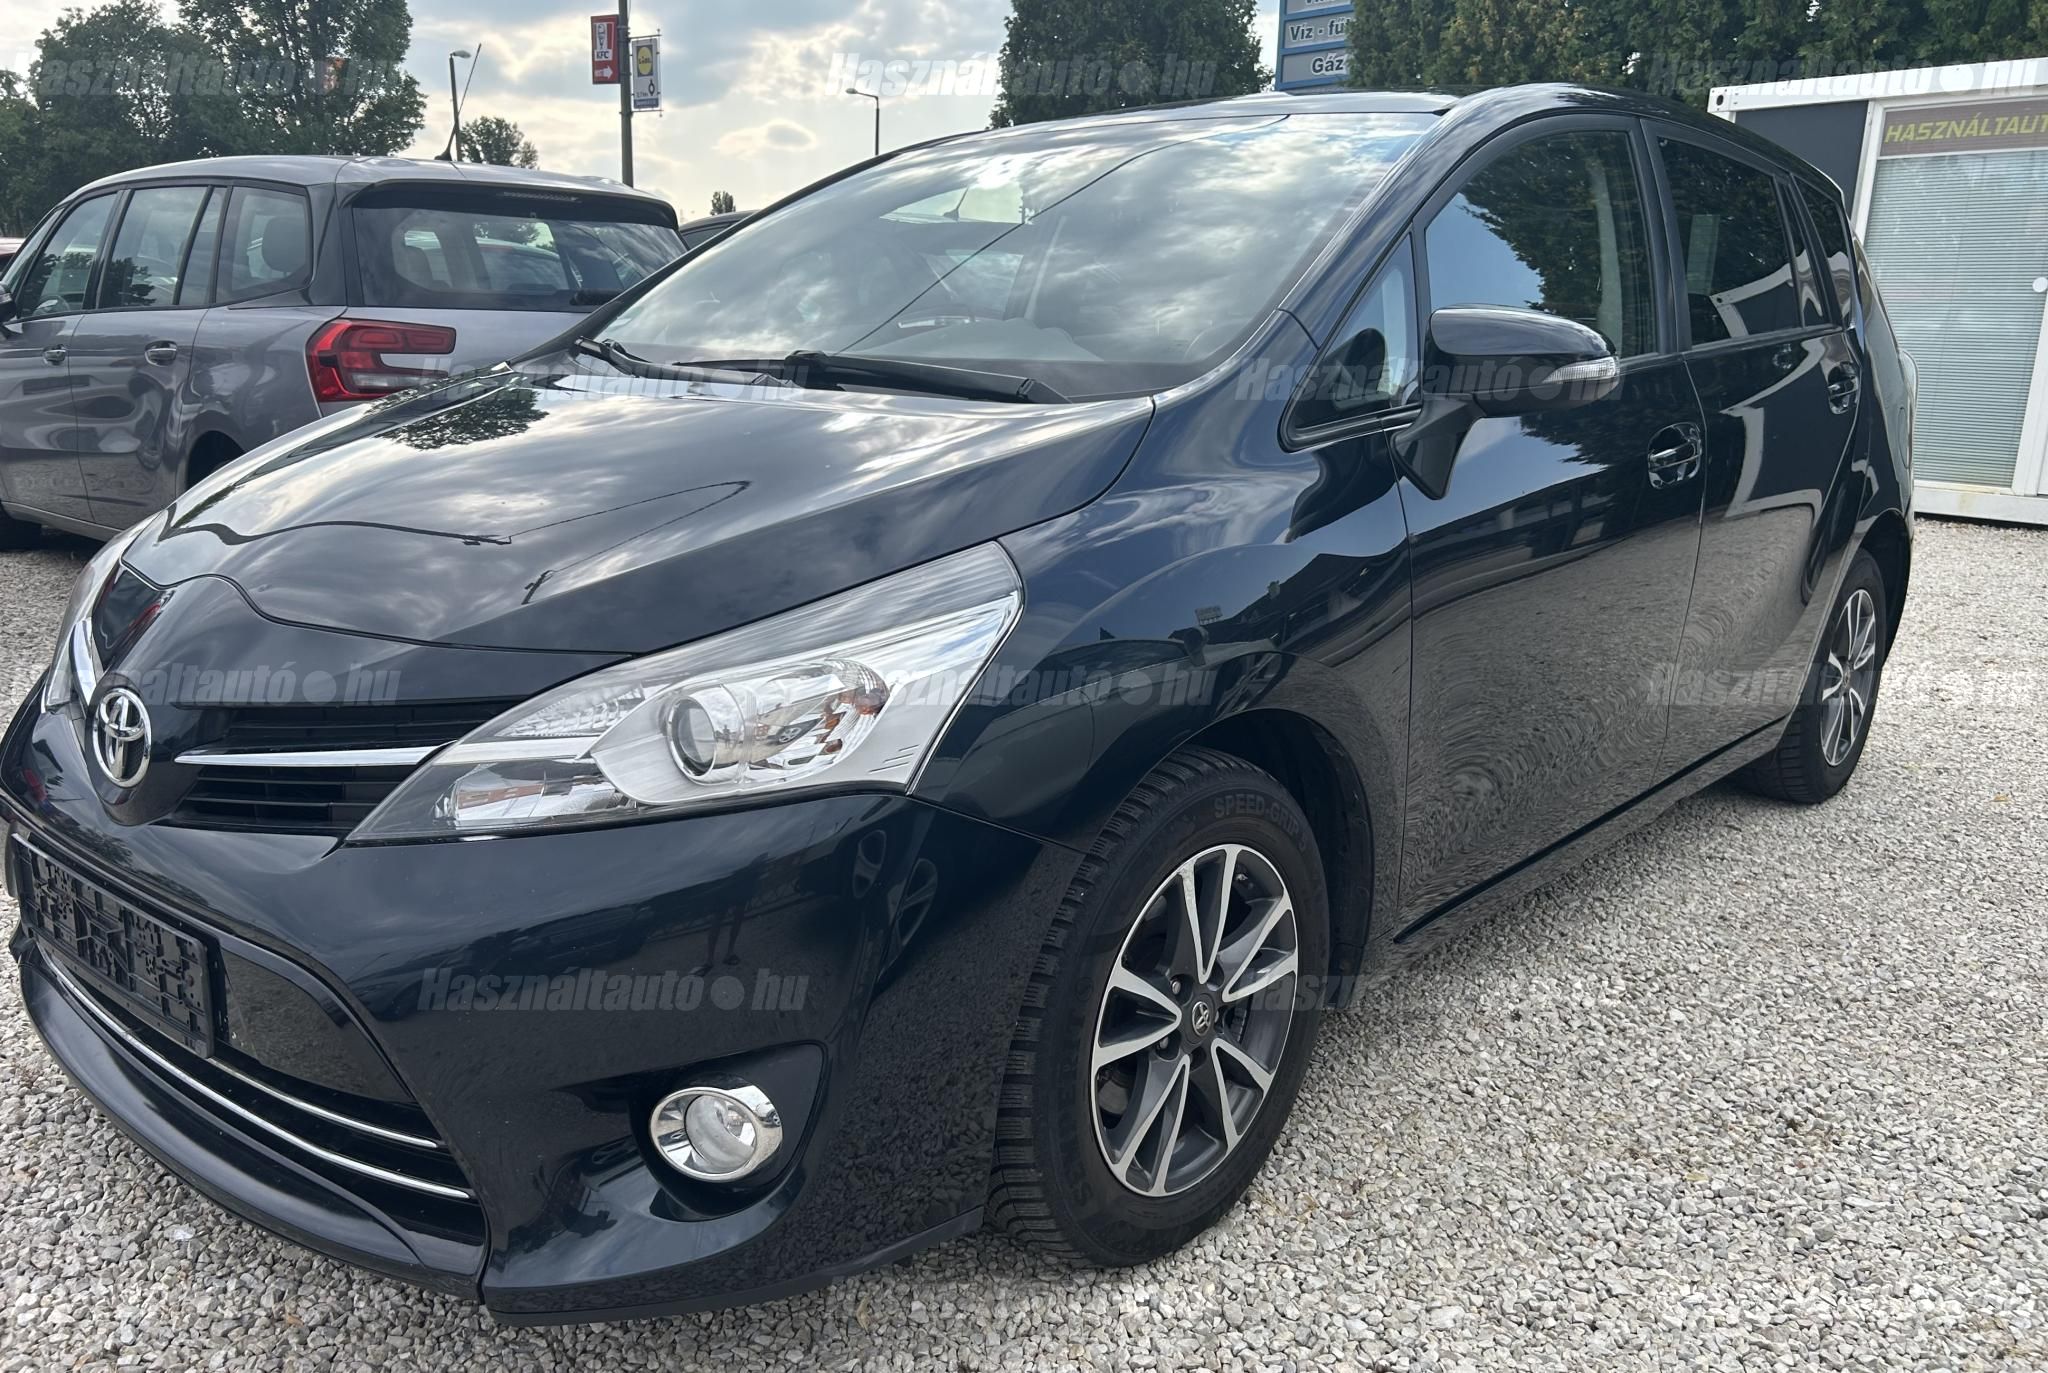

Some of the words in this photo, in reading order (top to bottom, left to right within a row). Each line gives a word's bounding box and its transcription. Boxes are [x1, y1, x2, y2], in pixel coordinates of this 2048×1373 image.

[1290, 22, 1313, 40] Víz
[596, 51, 609, 59] KFC
[1312, 55, 1343, 73] Gáz
[1214, 794, 1300, 834] SPEED-GRIP
